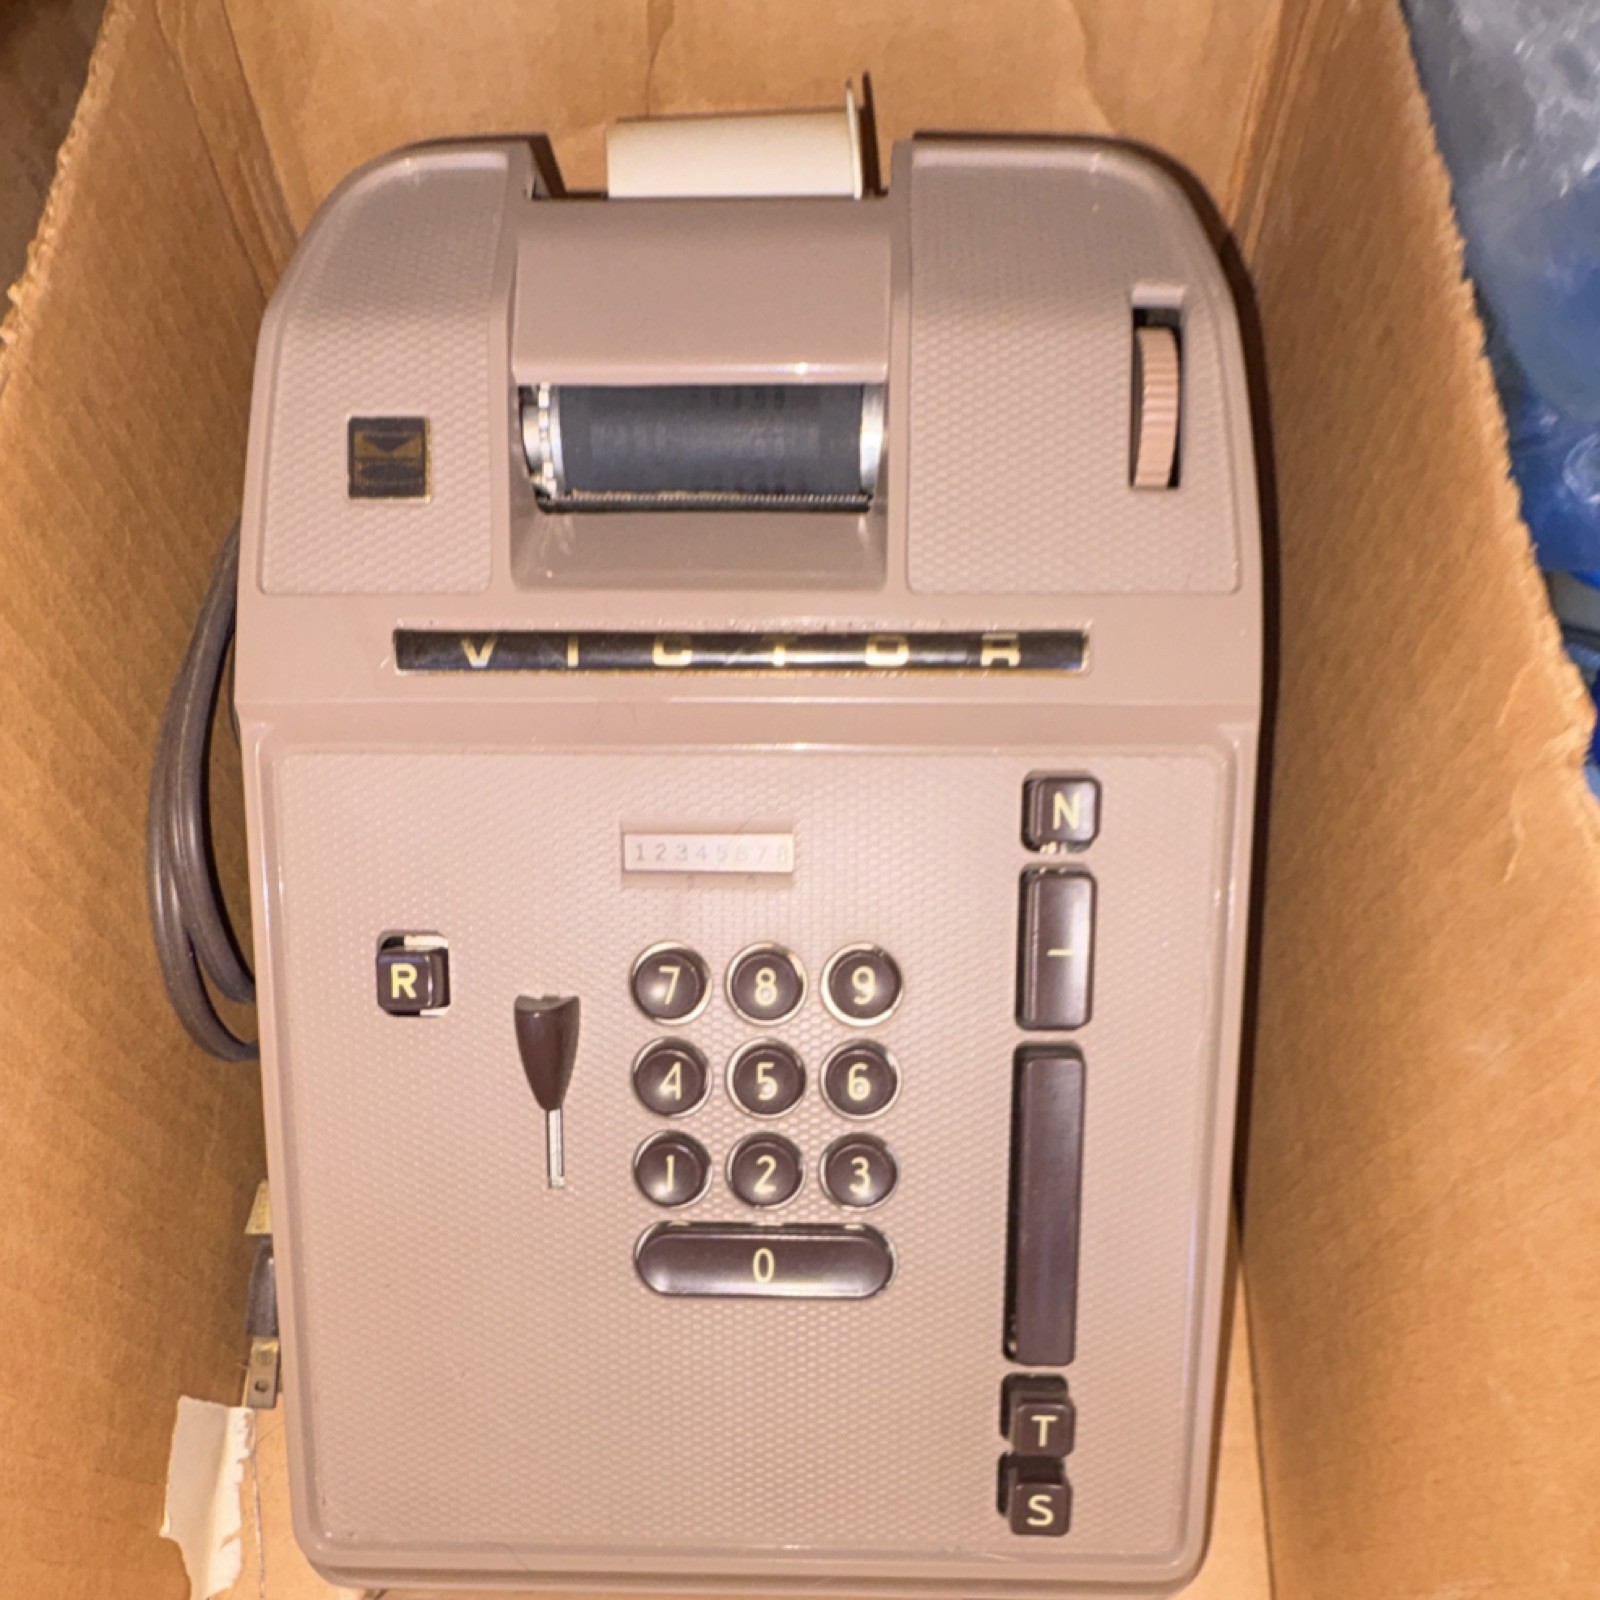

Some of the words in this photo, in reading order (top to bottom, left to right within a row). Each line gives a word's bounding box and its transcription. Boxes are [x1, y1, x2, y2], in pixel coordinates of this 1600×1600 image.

[460, 633, 1021, 667] VICTOR
[1052, 790, 1081, 830] N
[390, 962, 417, 999] R
[659, 965, 681, 1005] 7
[755, 967, 778, 1007] 8
[852, 965, 876, 1005] 9
[659, 1062, 682, 1101] 4
[757, 1062, 778, 1101] 5
[849, 1063, 871, 1101] 6
[666, 1154, 675, 1194] 1
[754, 1155, 777, 1194] 2
[849, 1156, 871, 1195] 3
[753, 1248, 775, 1284] 0
[1030, 1414, 1058, 1448] T
[1026, 1494, 1054, 1526] S
